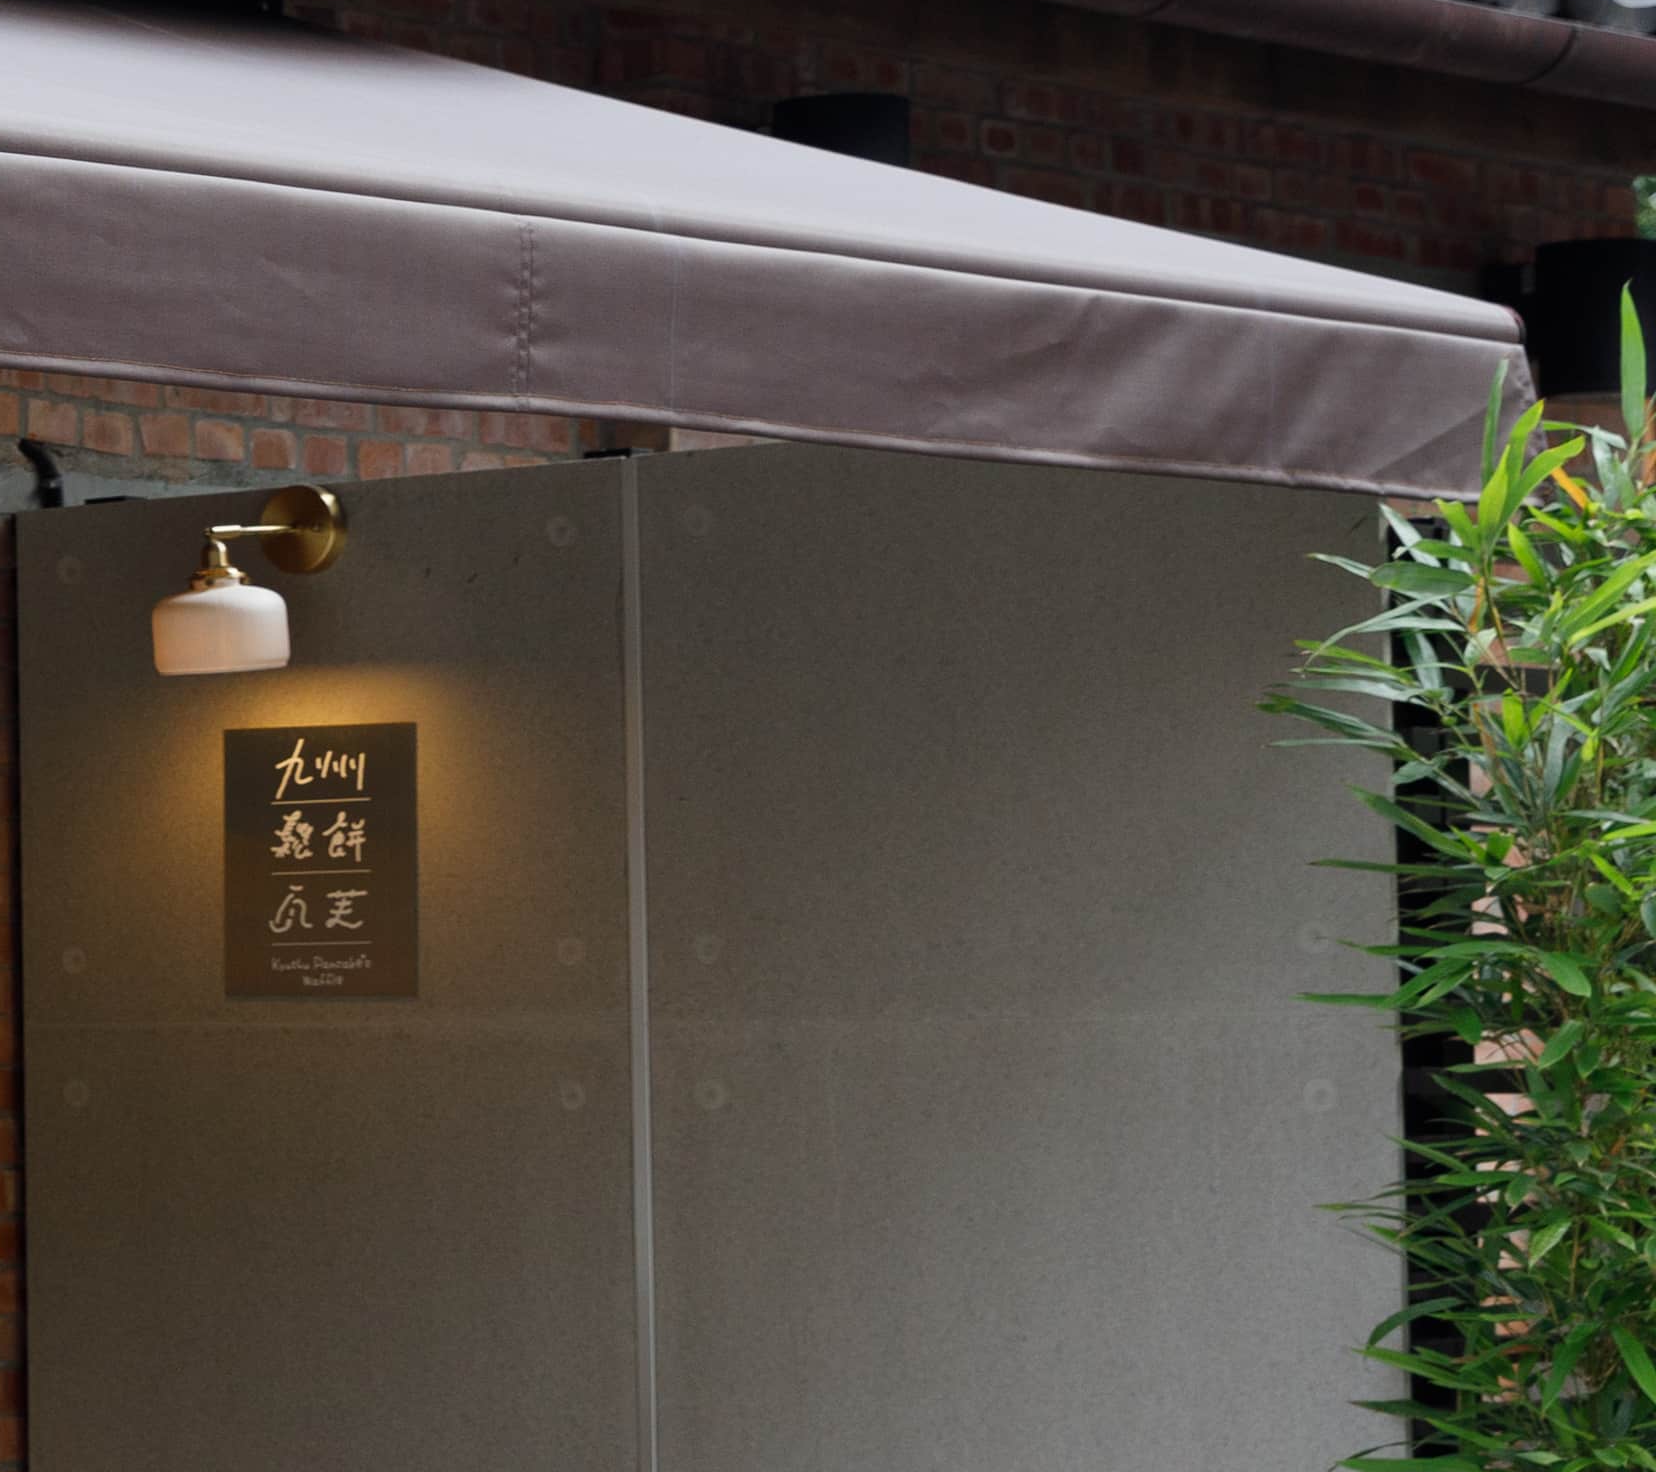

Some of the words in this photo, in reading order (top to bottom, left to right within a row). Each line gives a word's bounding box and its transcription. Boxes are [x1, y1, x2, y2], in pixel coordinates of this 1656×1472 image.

[275, 738, 366, 800] 九州
[270, 810, 367, 862] 鬆餅
[269, 885, 368, 933] 瓦芙
